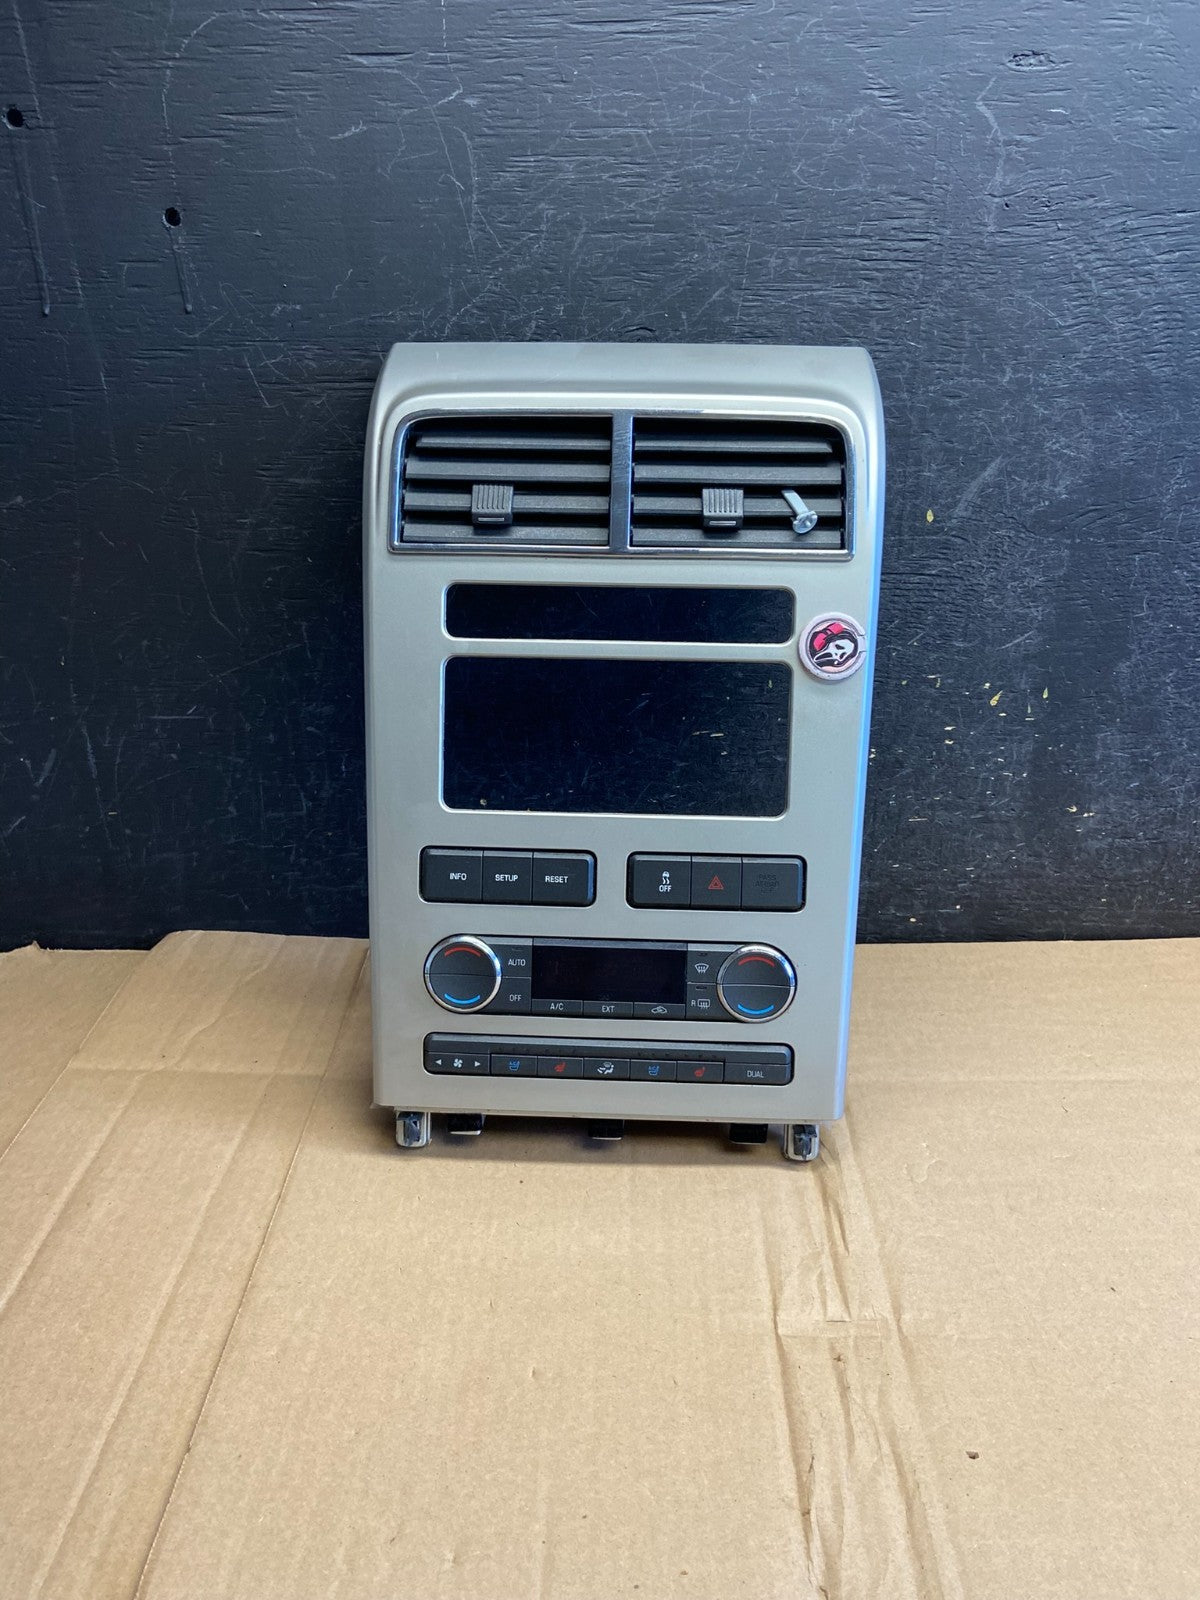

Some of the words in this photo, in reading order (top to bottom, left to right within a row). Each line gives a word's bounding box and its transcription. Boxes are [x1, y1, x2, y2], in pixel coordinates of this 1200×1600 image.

[449, 873, 467, 881] INFO
[495, 874, 519, 882] SETUP
[659, 885, 672, 893] OFF
[508, 959, 526, 967] AUTO
[509, 994, 522, 1002] OFF
[550, 1002, 564, 1011] A/C
[602, 1005, 616, 1013] EXT
[747, 1070, 764, 1078] DUAL
